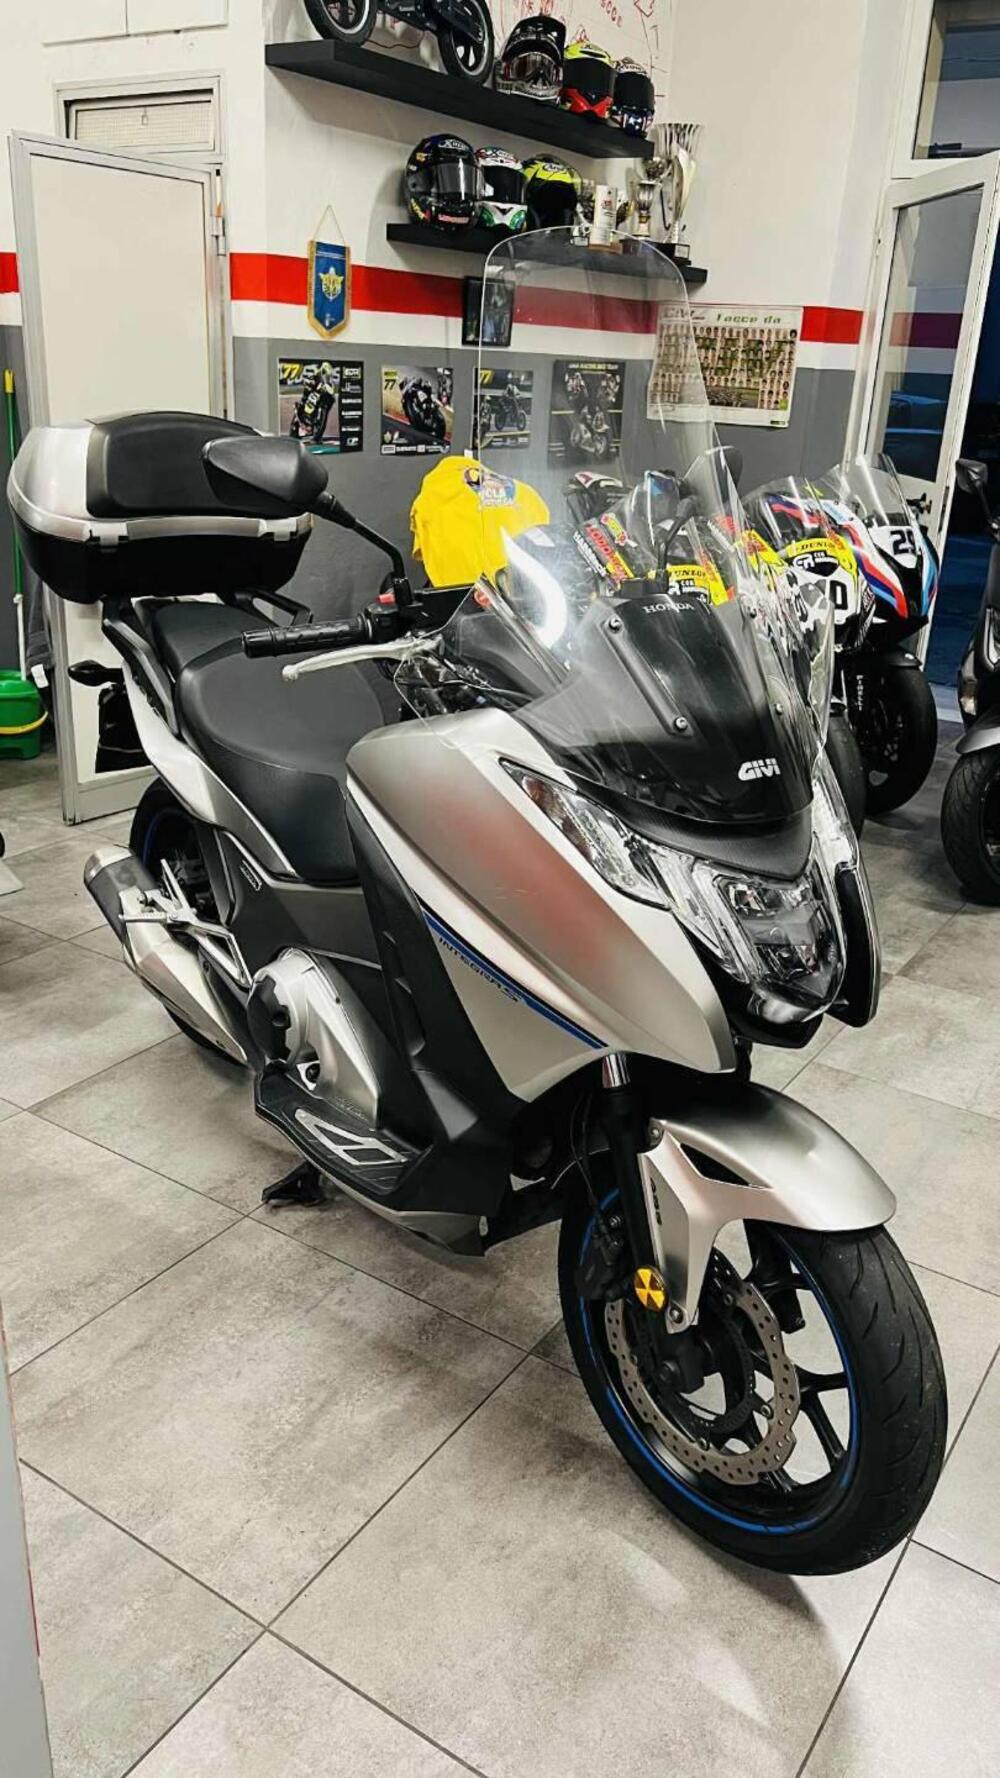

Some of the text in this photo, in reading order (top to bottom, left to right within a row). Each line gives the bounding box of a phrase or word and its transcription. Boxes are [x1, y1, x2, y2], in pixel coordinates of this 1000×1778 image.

[281, 363, 300, 379] 77
[384, 379, 396, 390] 77
[642, 603, 695, 614] HONDA
[738, 757, 781, 781] GIVI
